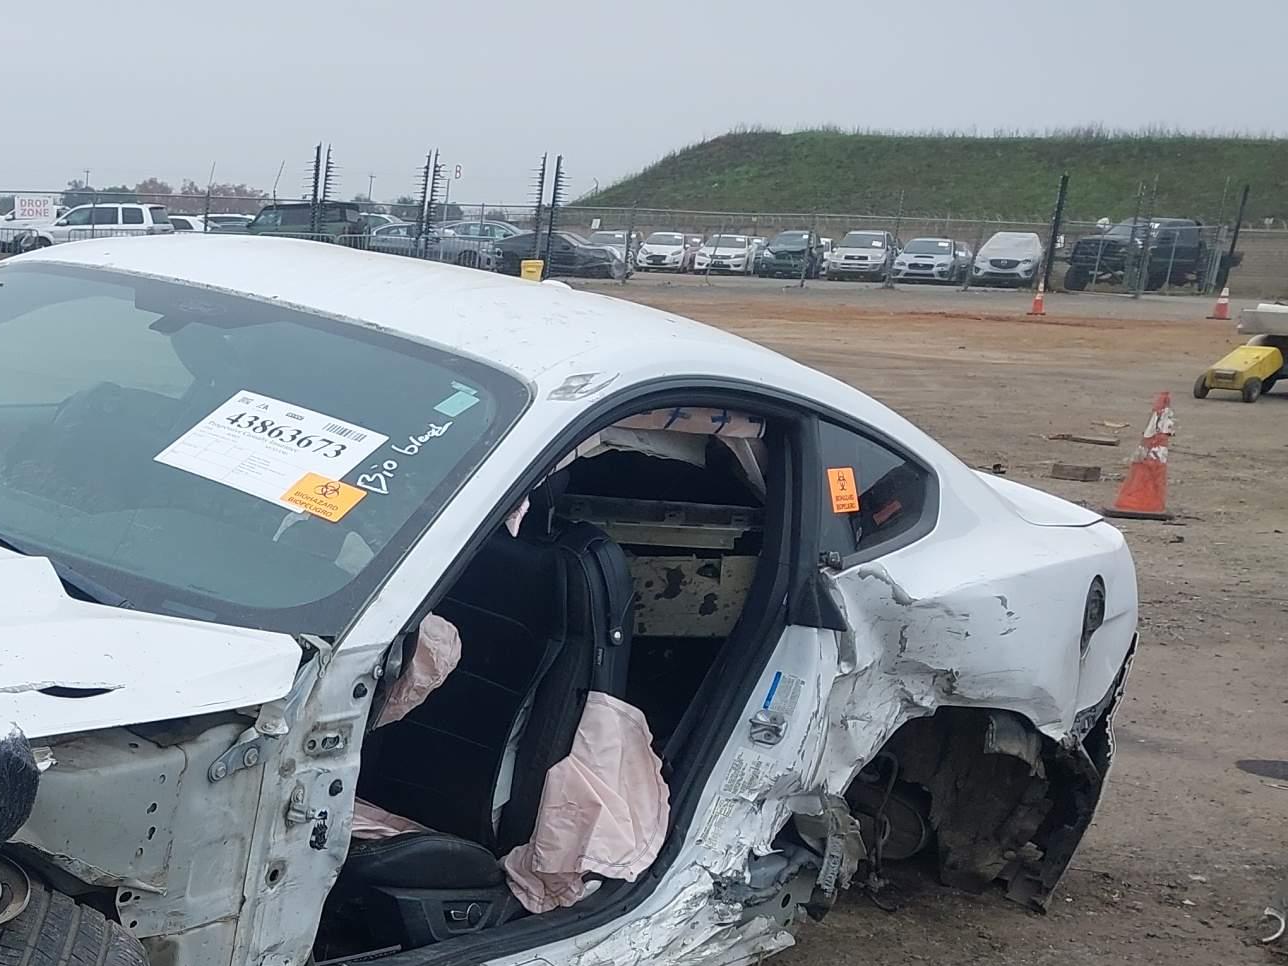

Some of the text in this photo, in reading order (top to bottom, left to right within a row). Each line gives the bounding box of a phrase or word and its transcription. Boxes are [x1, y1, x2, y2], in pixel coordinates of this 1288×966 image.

[20, 199, 49, 208] DROP
[20, 208, 50, 217] ZONE
[225, 411, 347, 459] 43863673
[356, 459, 398, 494] Bio
[294, 490, 339, 511] BIOHAZARD
